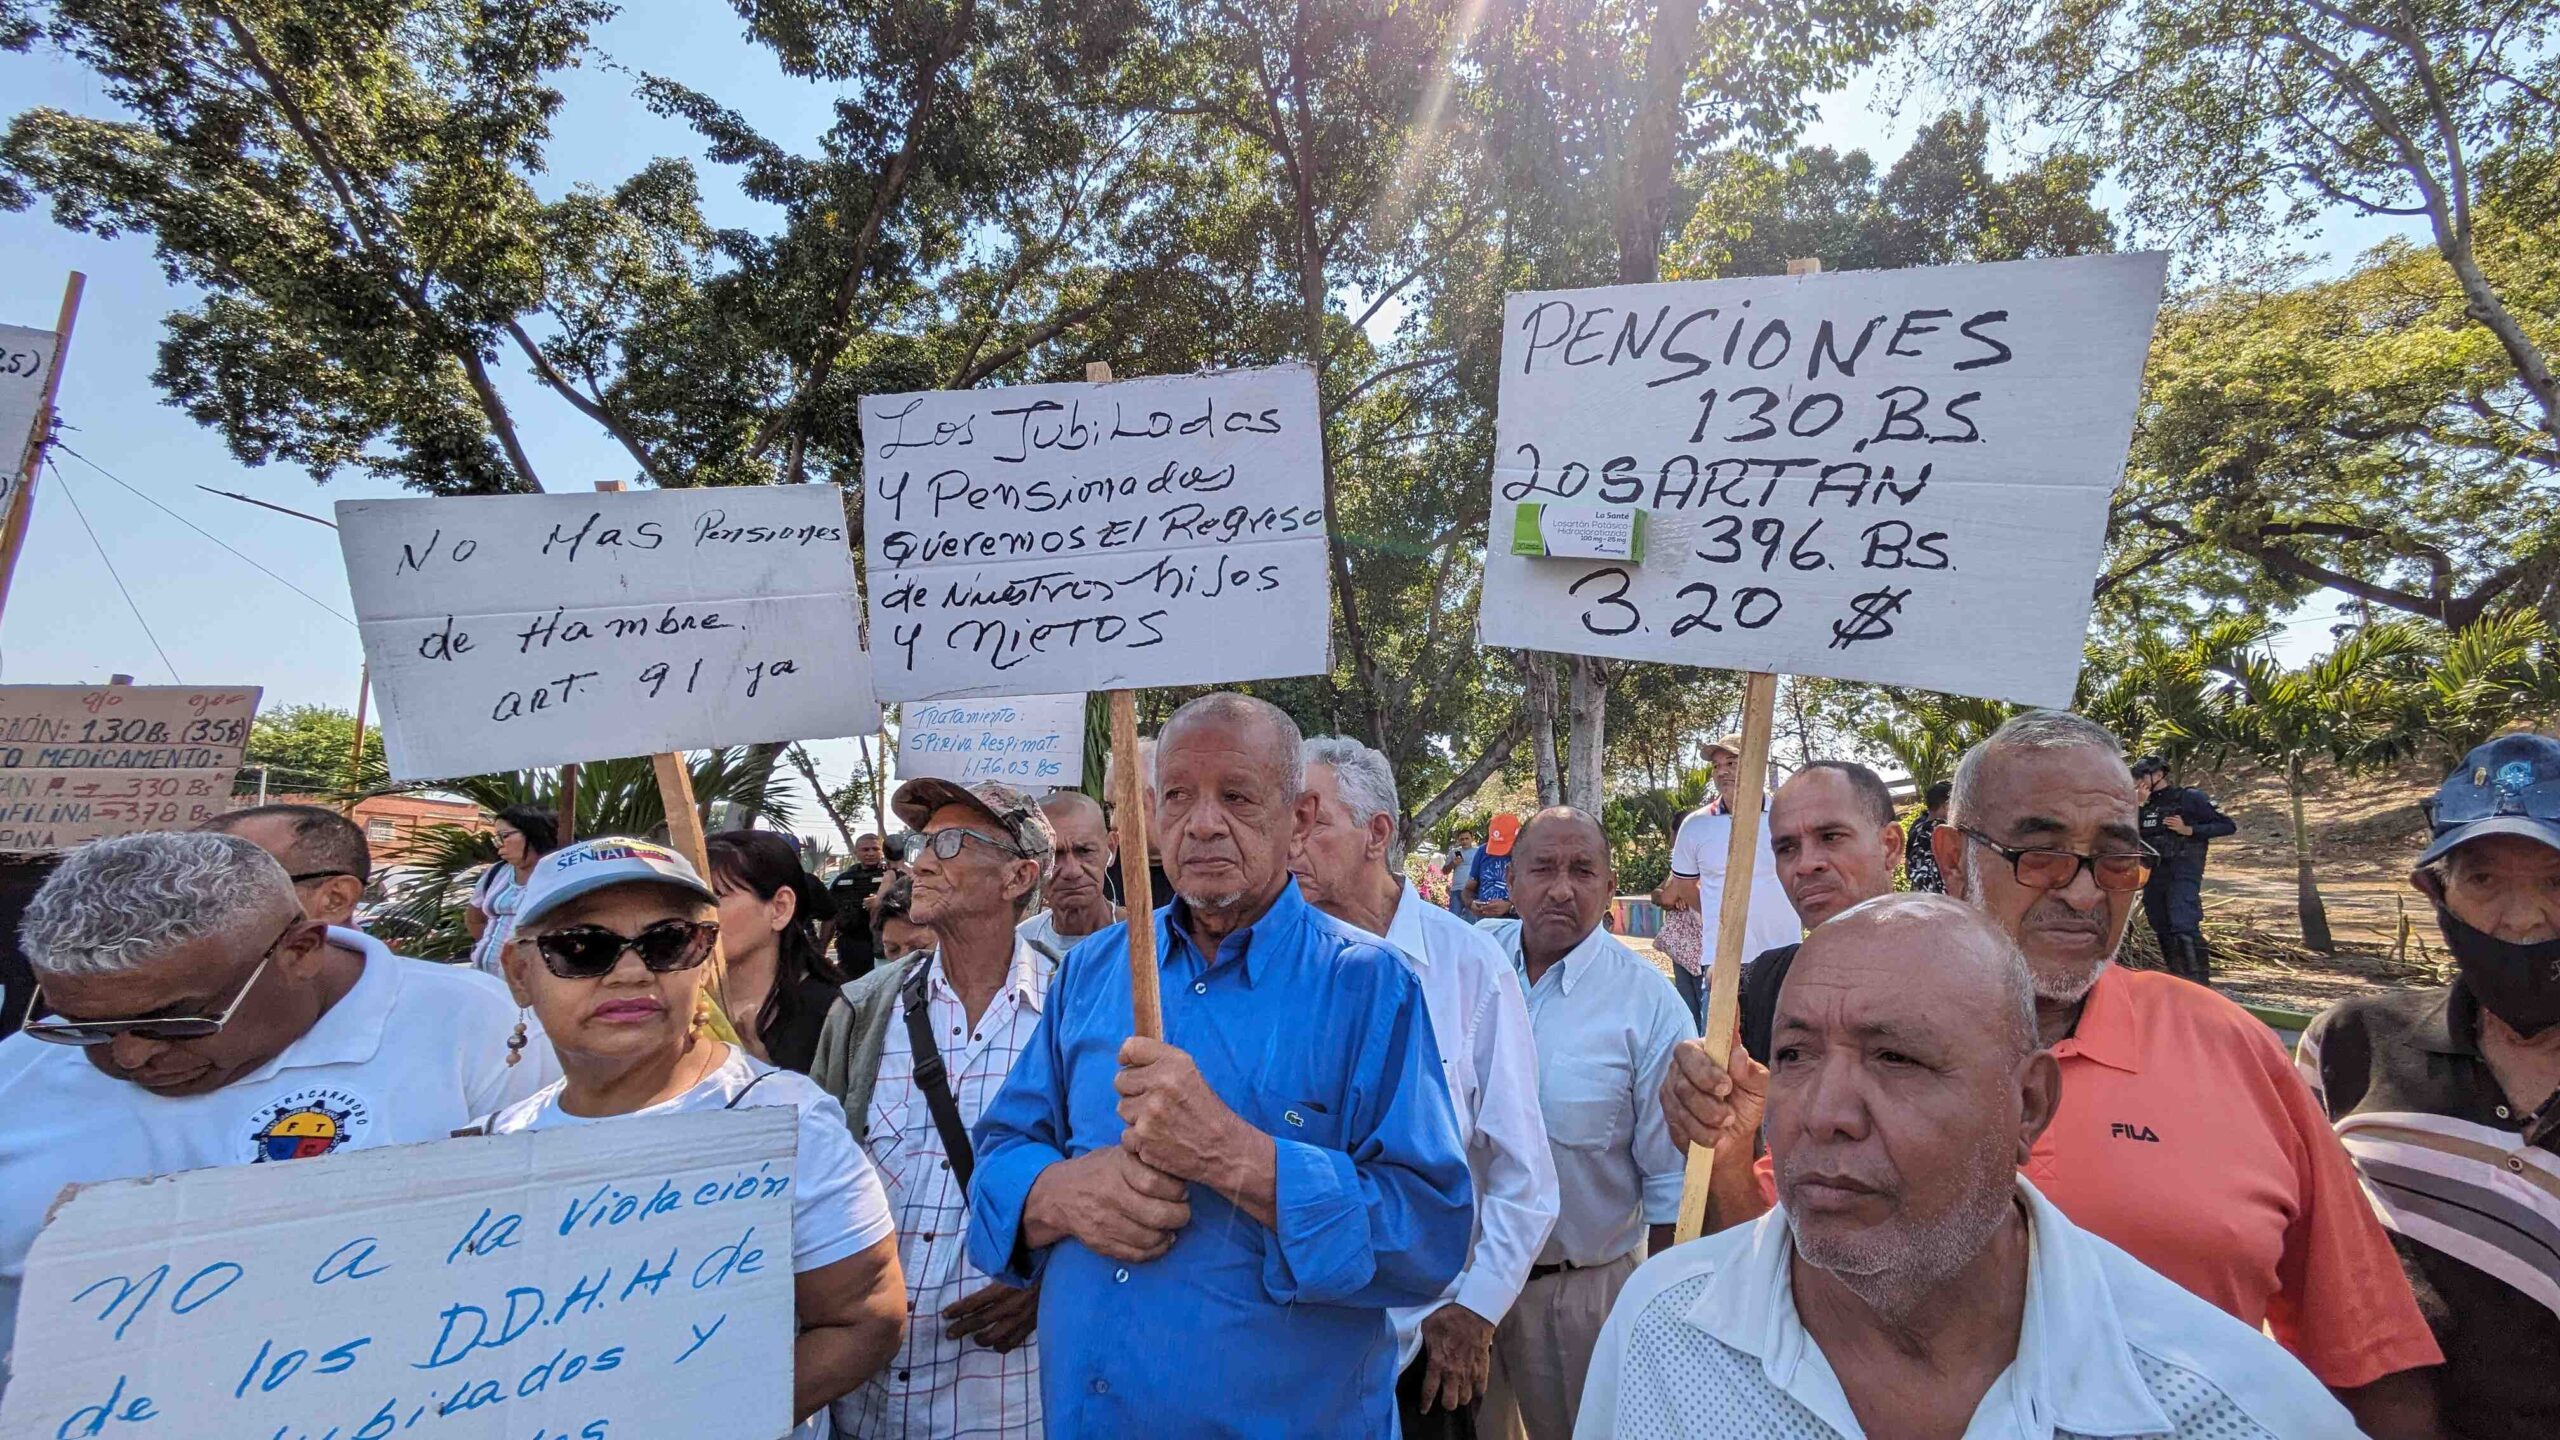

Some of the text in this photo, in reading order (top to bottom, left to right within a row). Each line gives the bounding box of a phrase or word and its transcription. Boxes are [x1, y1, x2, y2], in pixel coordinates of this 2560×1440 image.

[875, 398, 975, 459] Los
[694, 508, 842, 547] Pensiones
[1158, 502, 1326, 543] Regreso
[1552, 520, 1590, 529] Losartán
[1595, 511, 1630, 520] La Santé
[882, 573, 928, 611] de
[1568, 567, 1912, 649] 3.20 $
[419, 614, 476, 660] de
[126, 777, 181, 799] 330
[124, 801, 179, 827] 378
[2111, 1122, 2160, 1143] FILA
[446, 1203, 522, 1265] la
[57, 1374, 161, 1440] de
[235, 1336, 372, 1400] los
[689, 1225, 768, 1293] de
